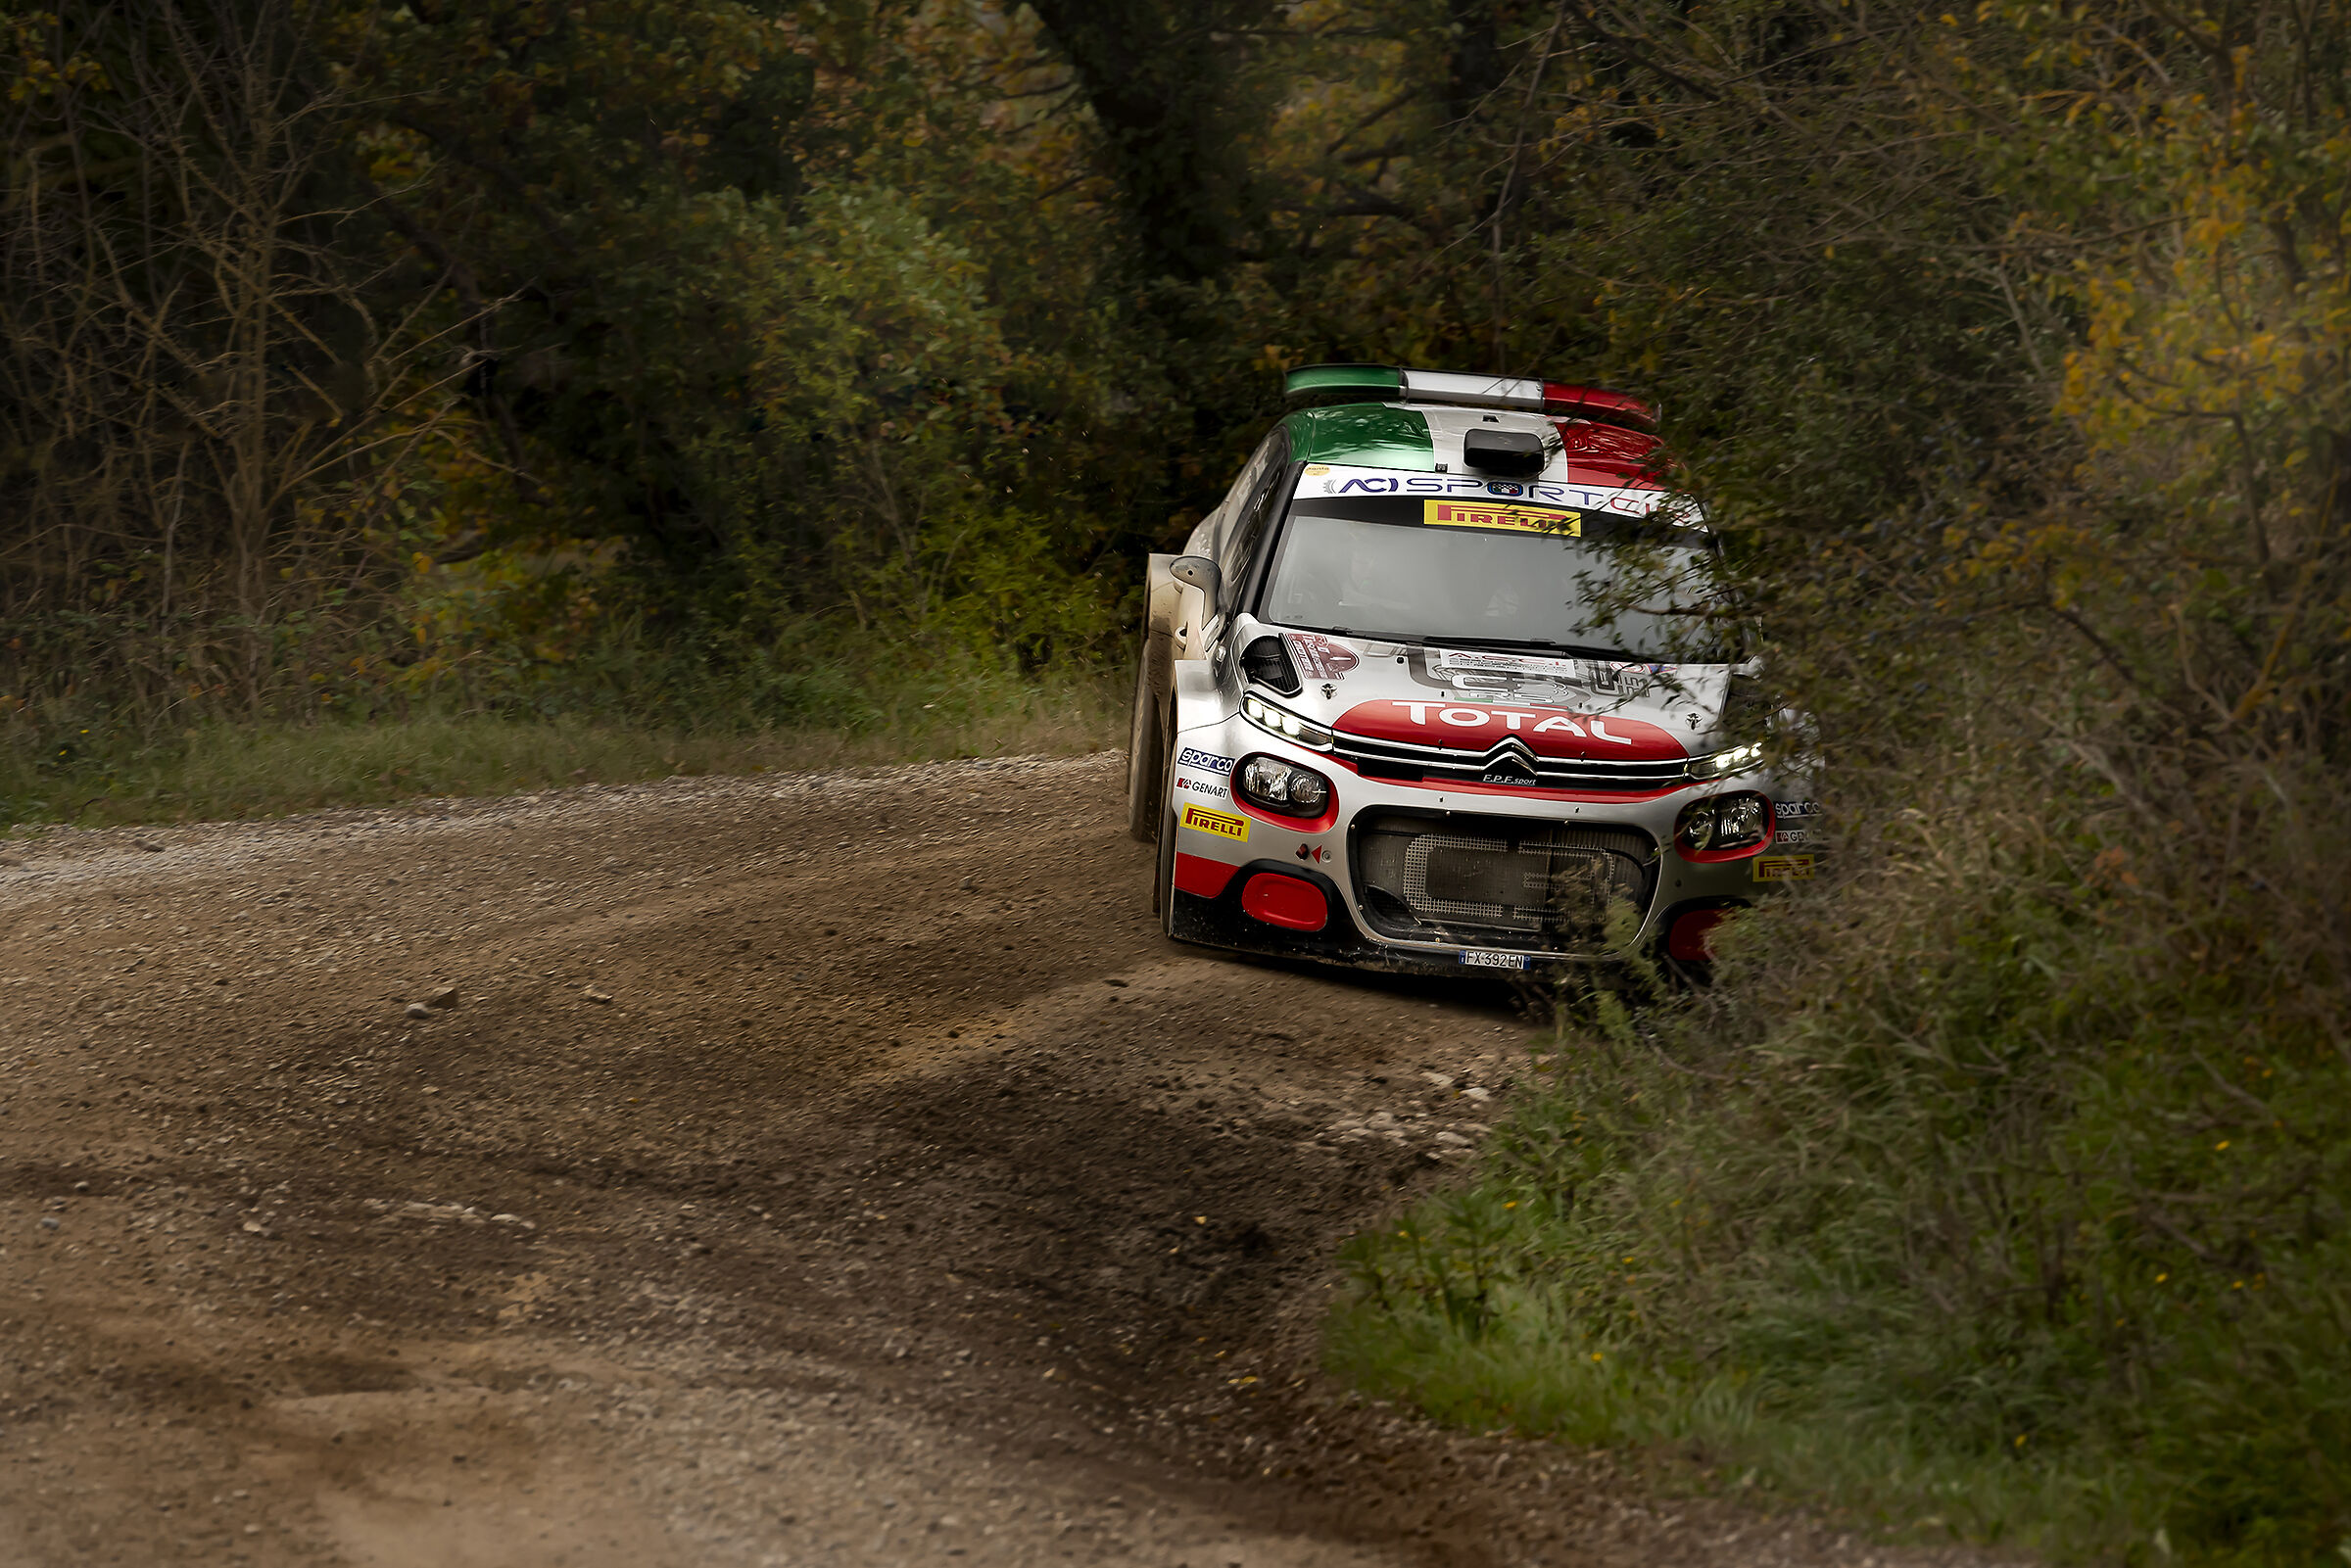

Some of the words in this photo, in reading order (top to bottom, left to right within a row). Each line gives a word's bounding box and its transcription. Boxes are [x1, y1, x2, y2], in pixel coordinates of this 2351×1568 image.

[1406, 477, 1605, 506] SPORT
[1391, 700, 1633, 745] TOTAL
[1179, 748, 1234, 772] sparco
[1184, 807, 1245, 837] PIRELLI
[1775, 802, 1820, 819] sparco
